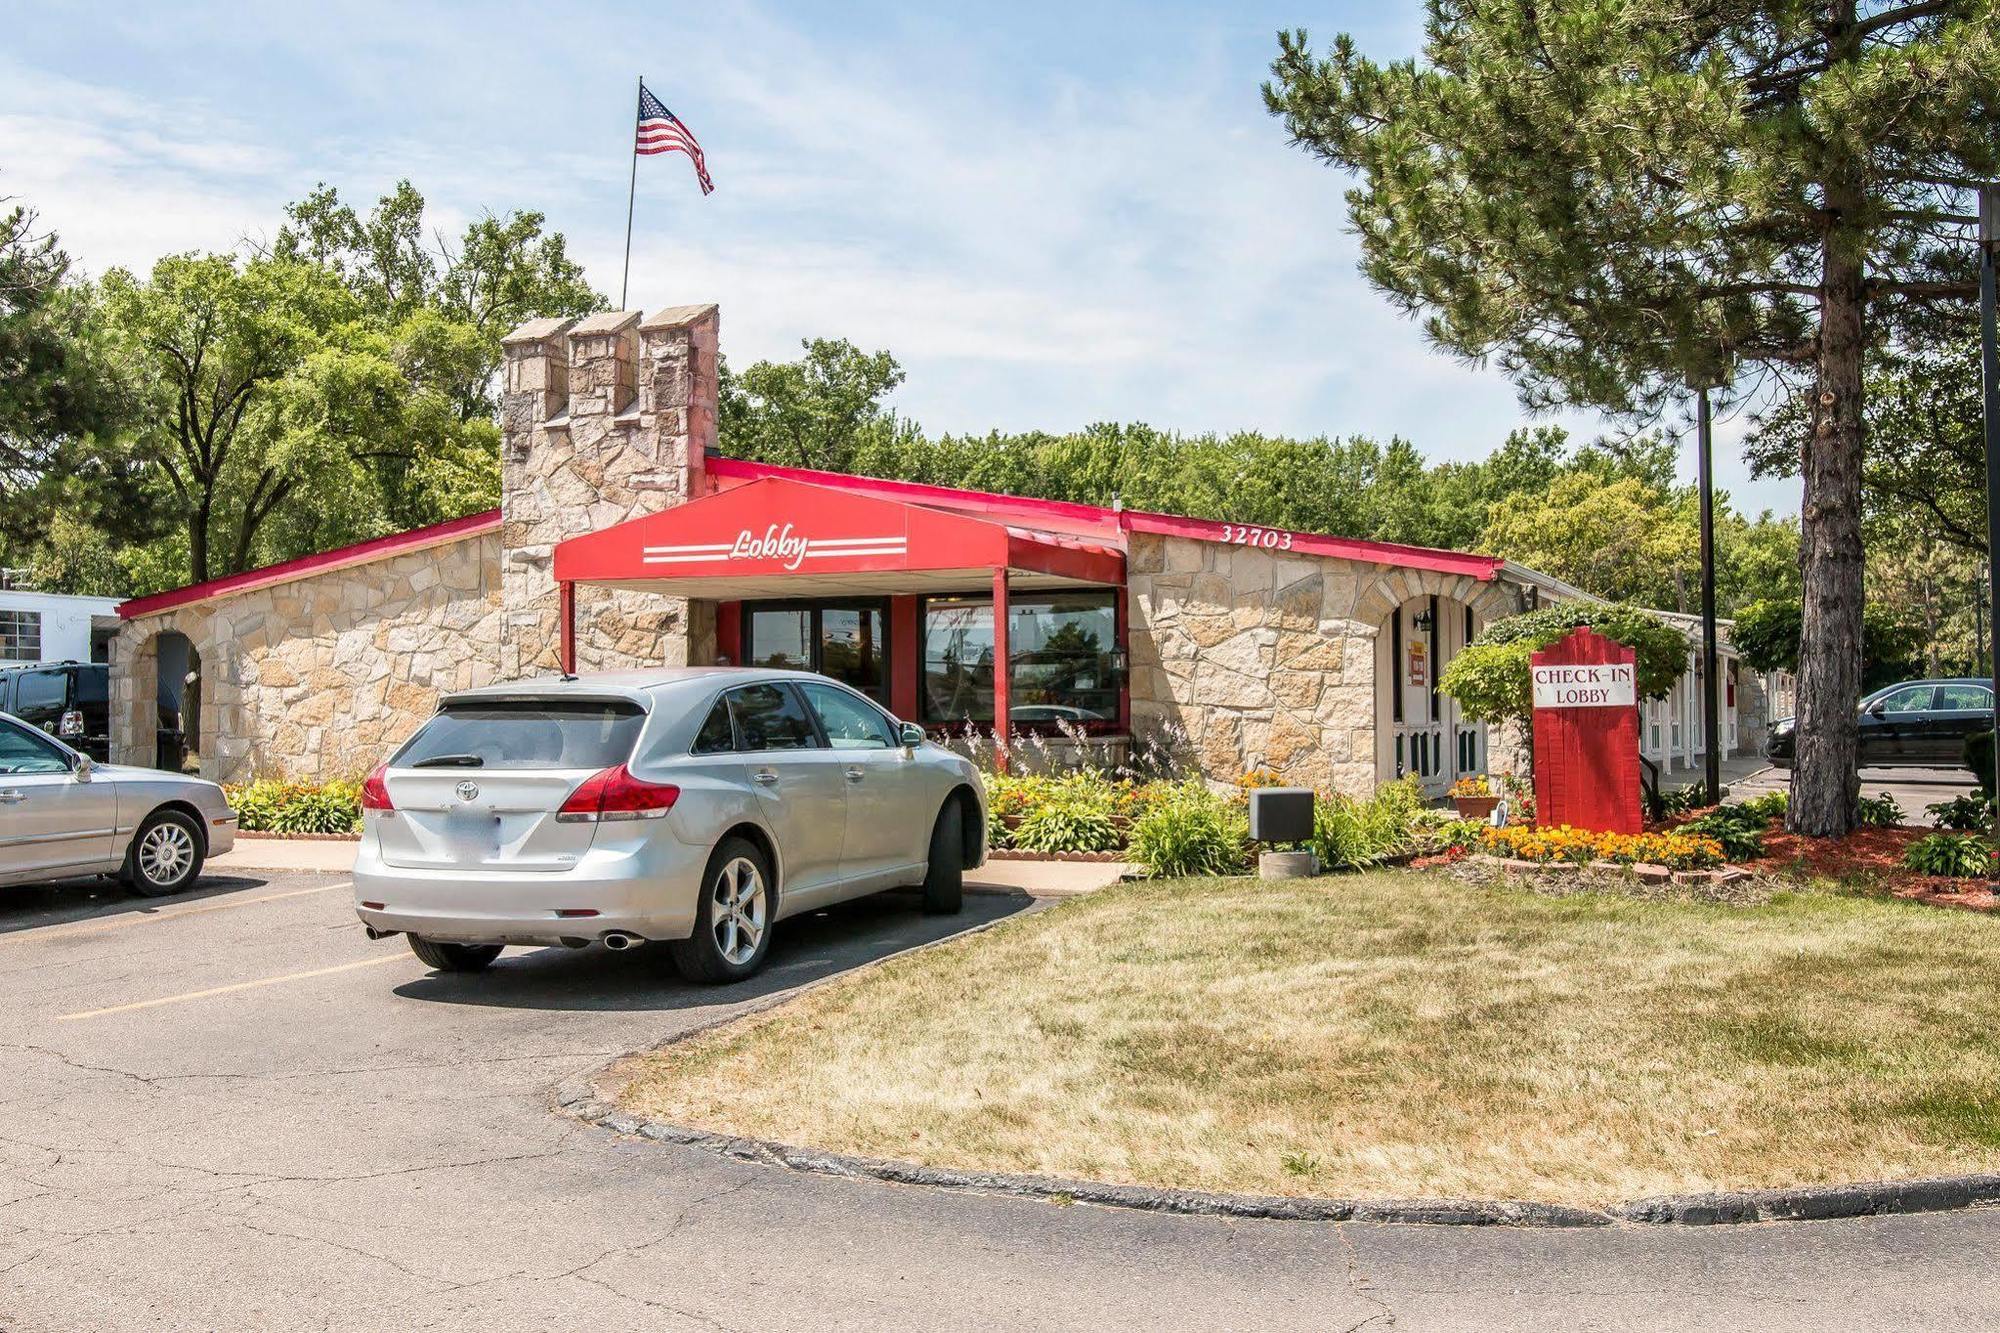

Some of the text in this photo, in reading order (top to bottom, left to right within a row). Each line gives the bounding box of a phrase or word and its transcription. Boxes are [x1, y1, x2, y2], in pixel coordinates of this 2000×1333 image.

[729, 523, 808, 570] Lobby
[1220, 525, 1292, 550] 32703
[1535, 668, 1630, 684] CHECK-IN
[1556, 689, 1609, 703] LOBBY
